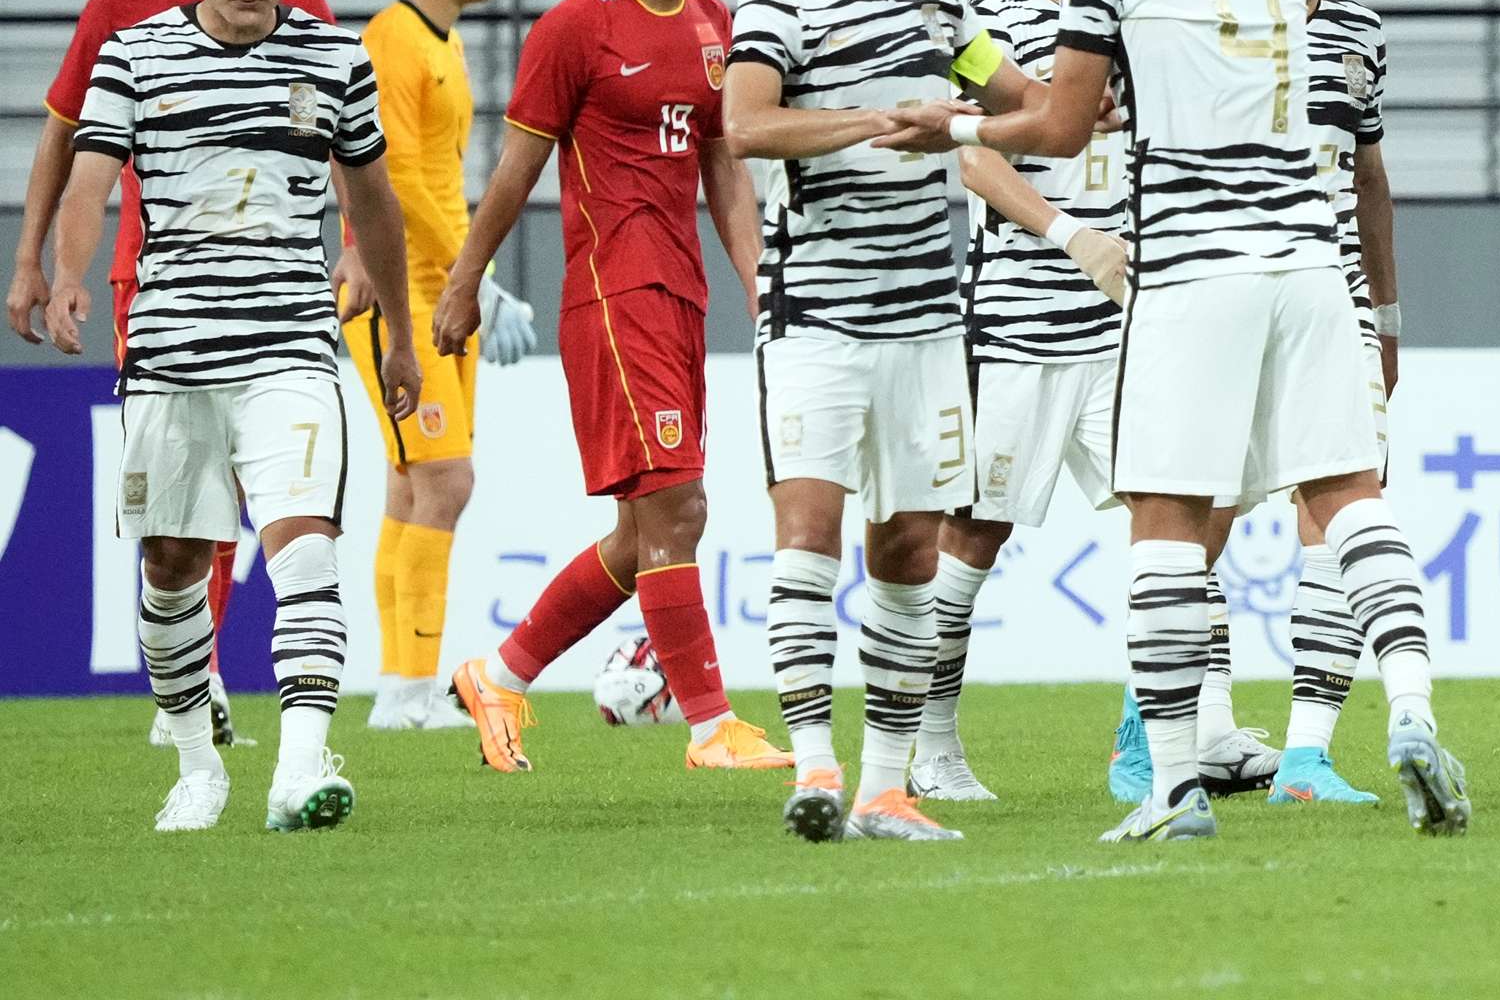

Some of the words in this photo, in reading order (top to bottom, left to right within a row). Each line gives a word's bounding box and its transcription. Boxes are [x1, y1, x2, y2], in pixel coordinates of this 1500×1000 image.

[659, 104, 694, 153] 19
[1085, 131, 1109, 191] 6
[226, 167, 257, 225] 7
[290, 422, 321, 478] 7
[938, 405, 966, 469] 3
